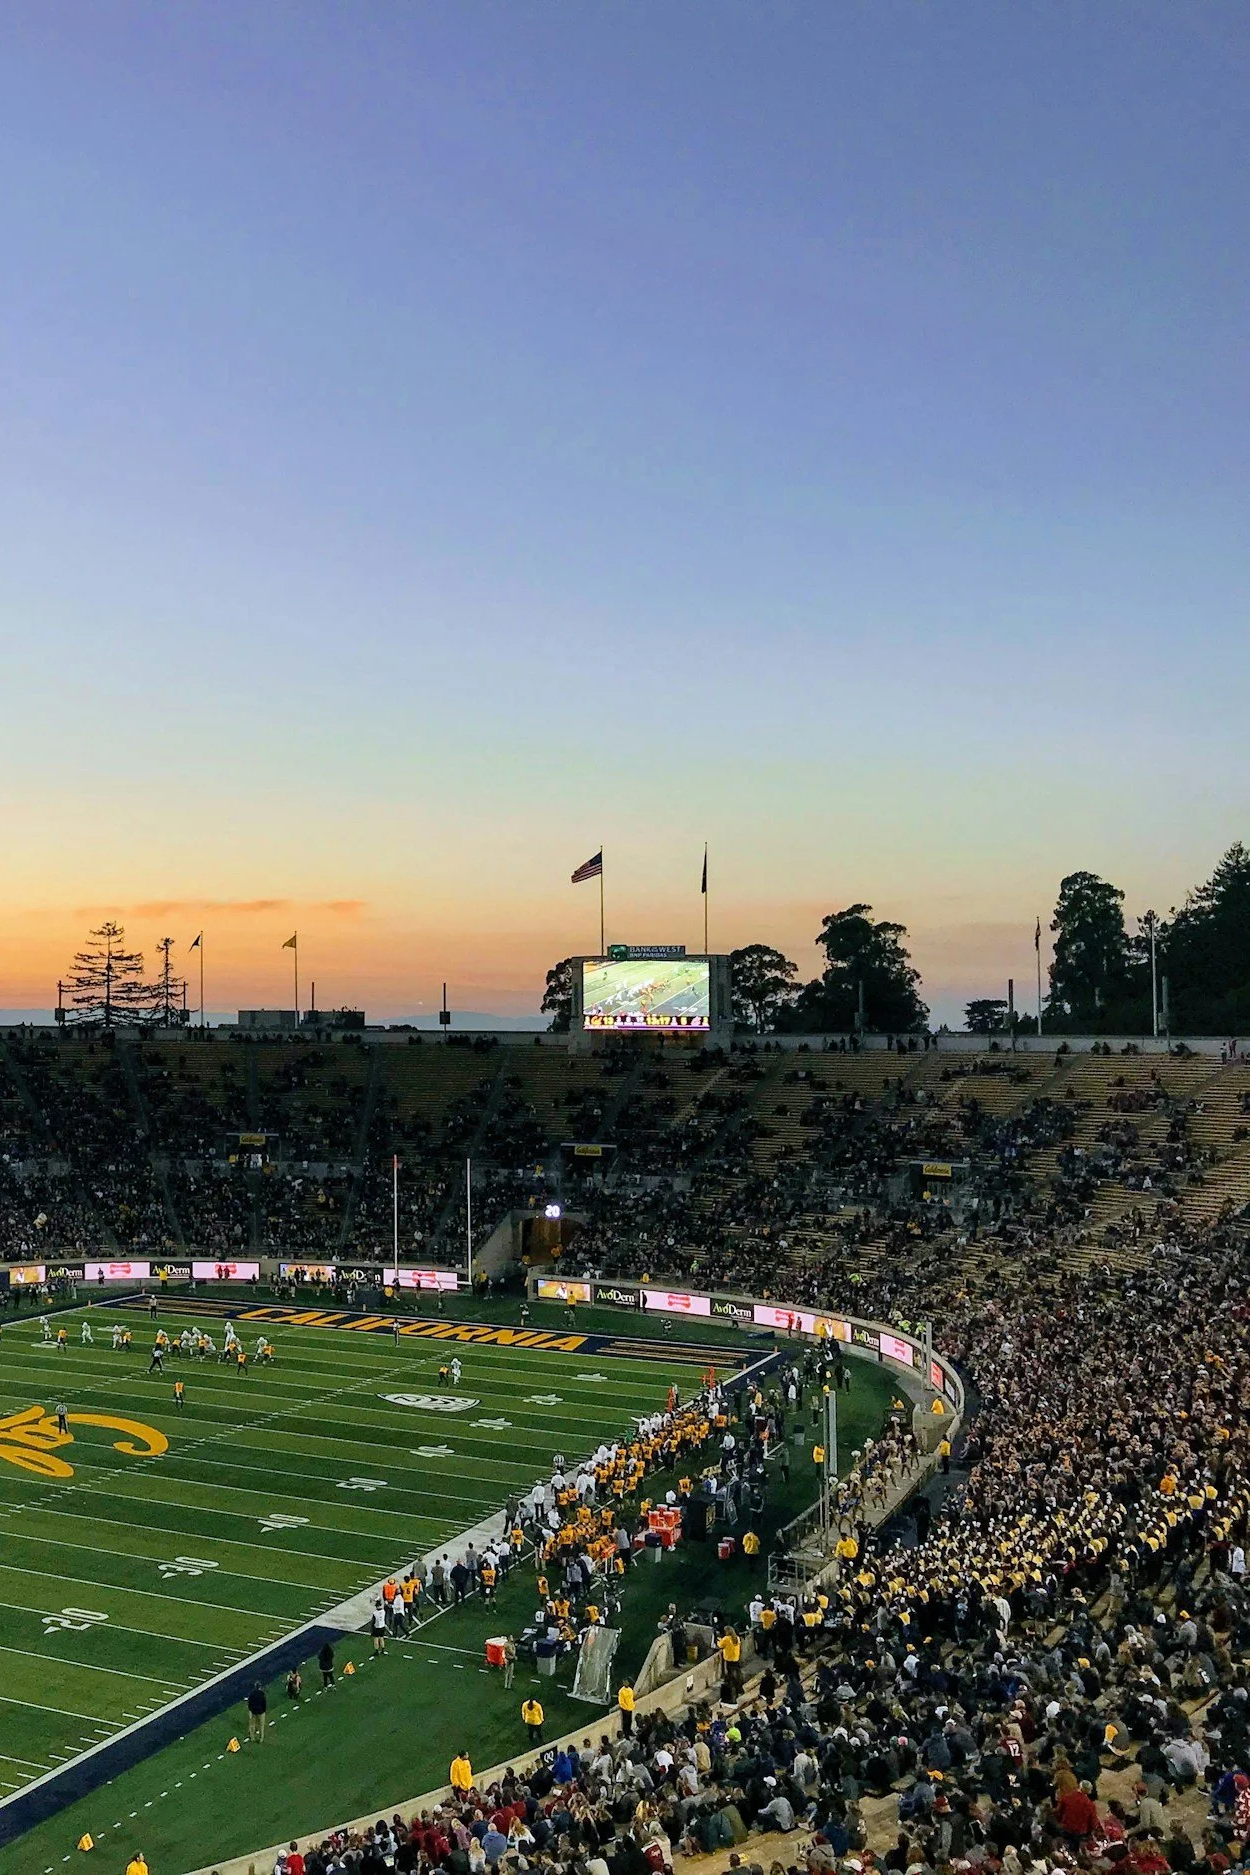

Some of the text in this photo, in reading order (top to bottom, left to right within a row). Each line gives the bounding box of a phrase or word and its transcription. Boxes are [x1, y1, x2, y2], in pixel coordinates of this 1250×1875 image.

[545, 1205, 560, 1217] 20
[237, 1308, 589, 1351] CALIFORNIA
[335, 1477, 388, 1491] 50
[157, 1556, 220, 1576] 30
[41, 1607, 110, 1631] 20
[1009, 1744, 1021, 1757] 12
